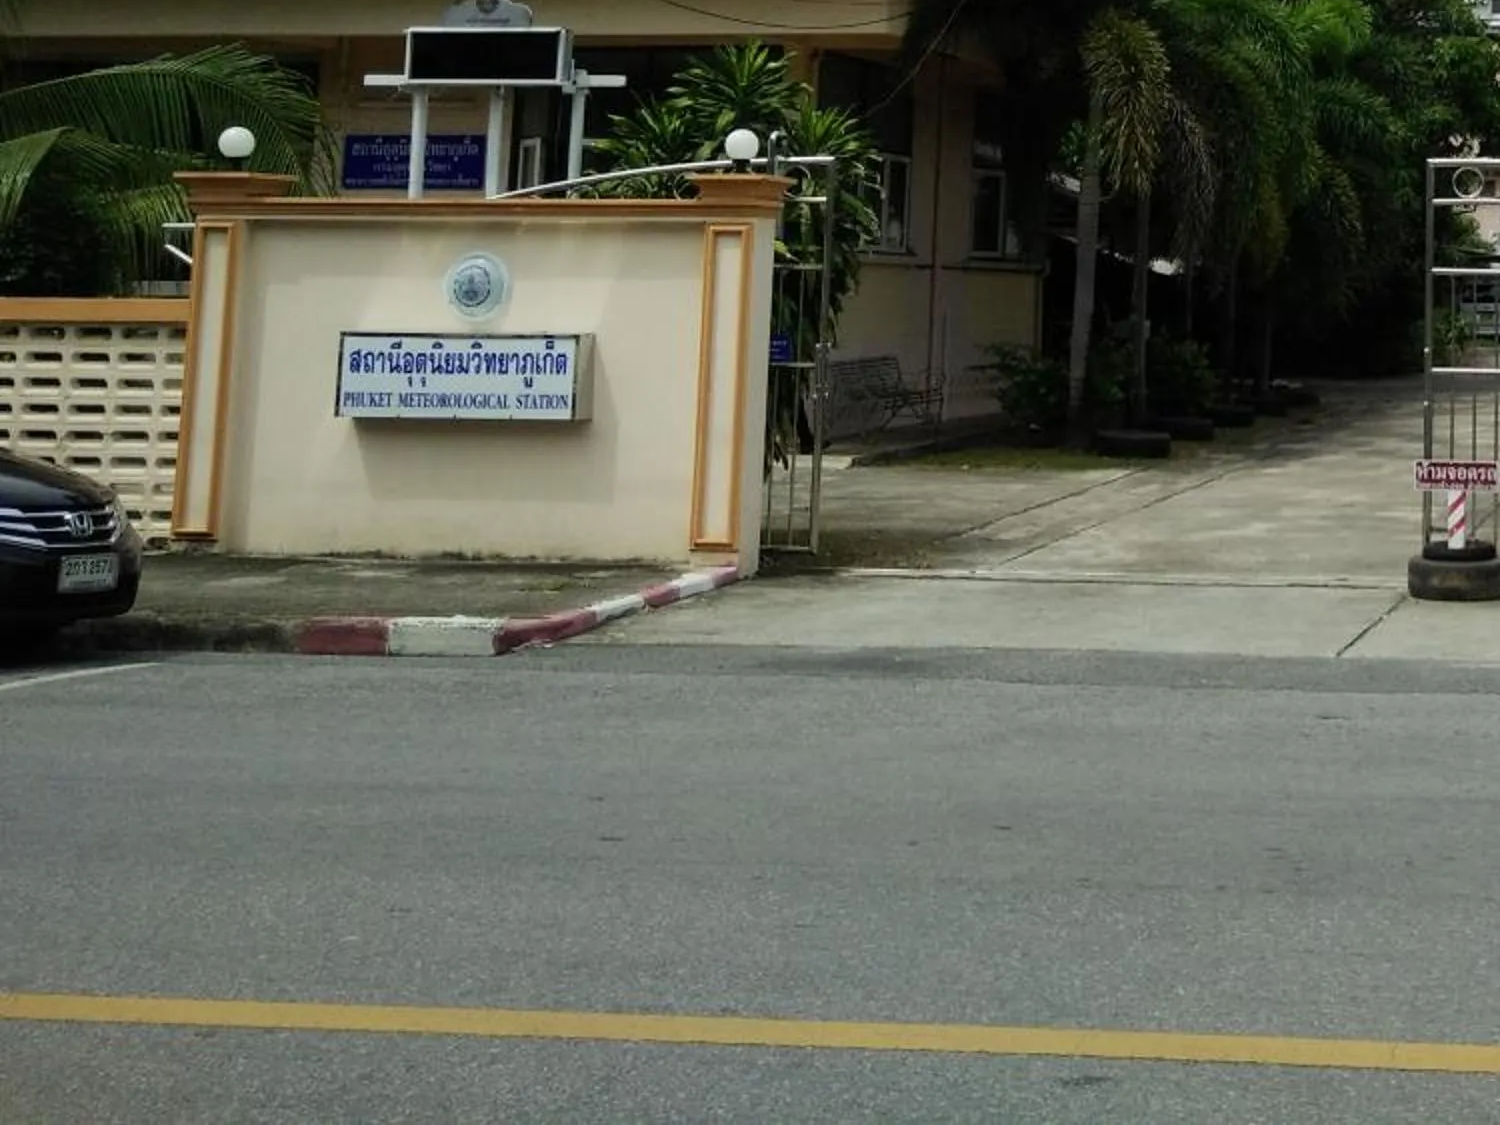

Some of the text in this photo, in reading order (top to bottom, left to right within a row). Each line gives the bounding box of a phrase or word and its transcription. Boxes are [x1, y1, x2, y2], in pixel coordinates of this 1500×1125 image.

[349, 337, 568, 388] สถานีอุตุนิยมวิทยาภูเก็ต
[343, 391, 569, 410] PHUKET METEOROLOGICAL STATION
